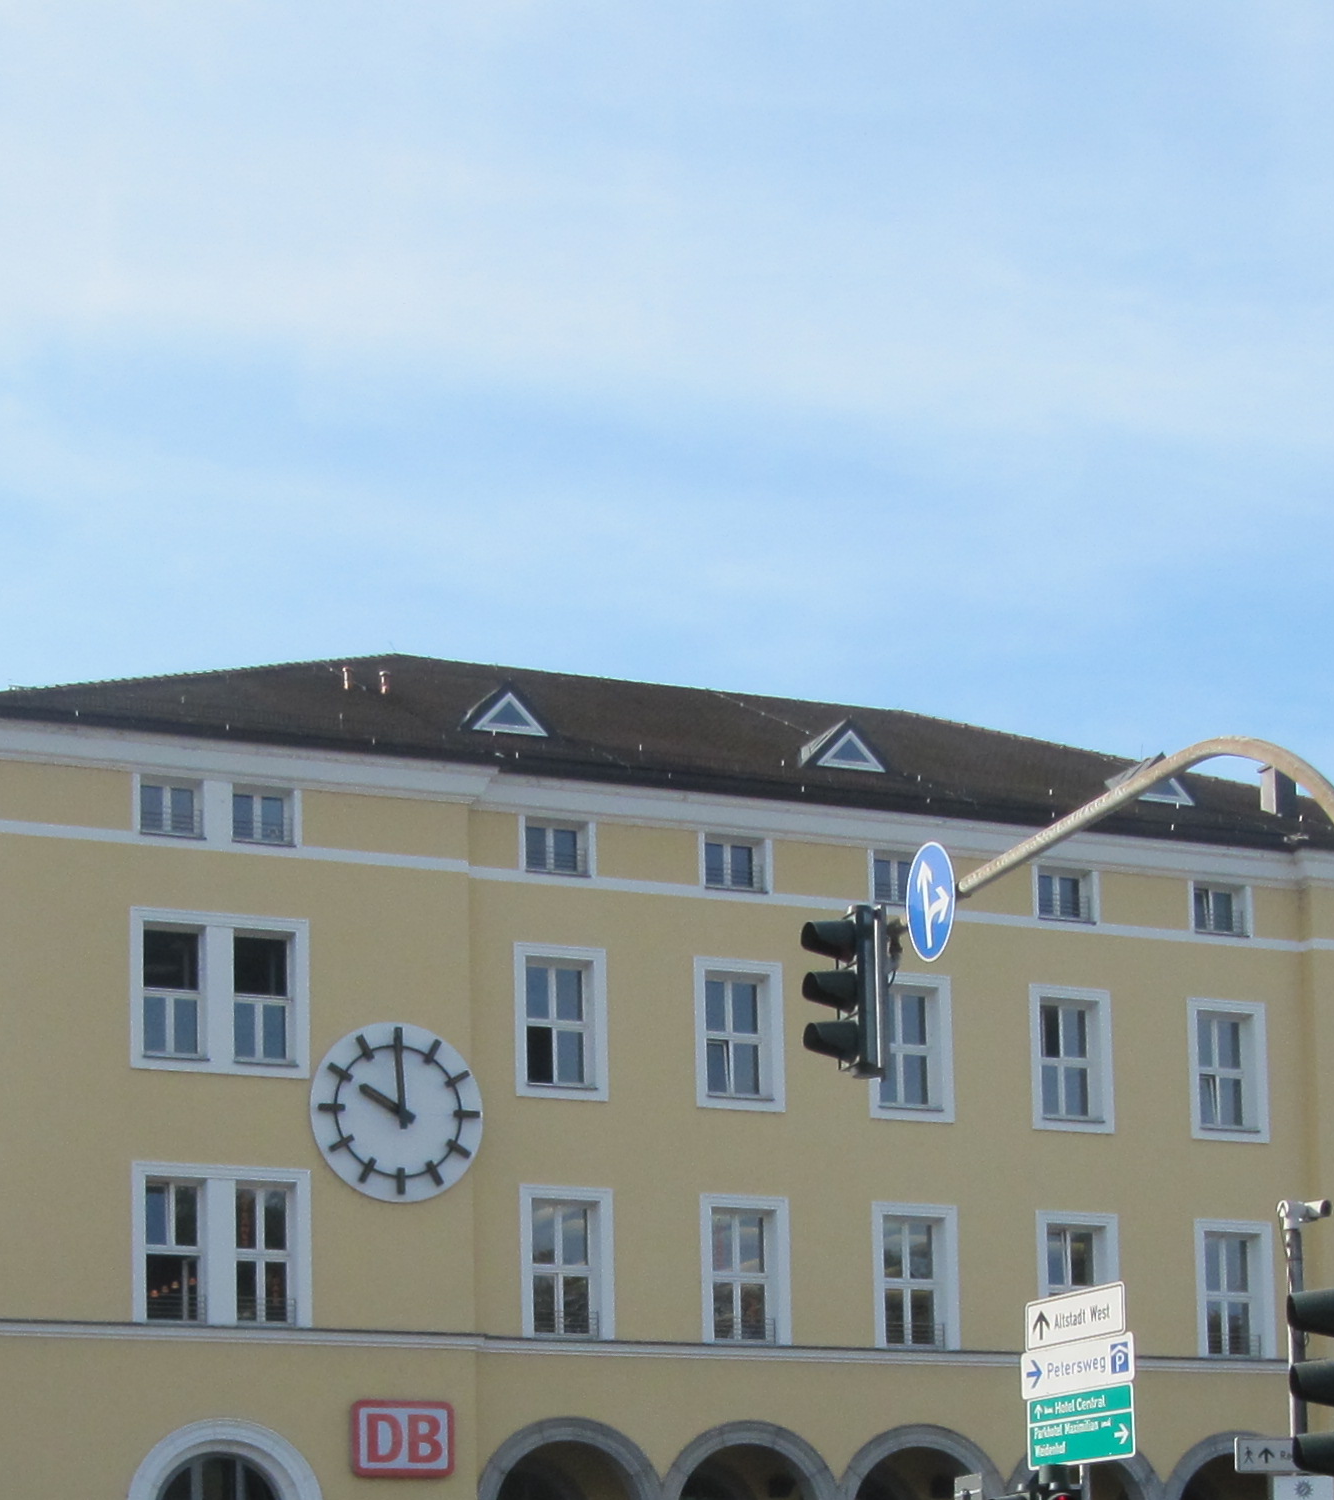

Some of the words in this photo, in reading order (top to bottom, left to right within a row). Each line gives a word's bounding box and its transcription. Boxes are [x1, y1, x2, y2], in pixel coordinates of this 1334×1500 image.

[1054, 1308, 1086, 1329] Altstadt
[1090, 1303, 1110, 1322] West
[1047, 1356, 1106, 1379] Petersweg
[1055, 1399, 1075, 1415] Hotel
[1076, 1395, 1106, 1411] Central
[367, 1413, 443, 1464] DB
